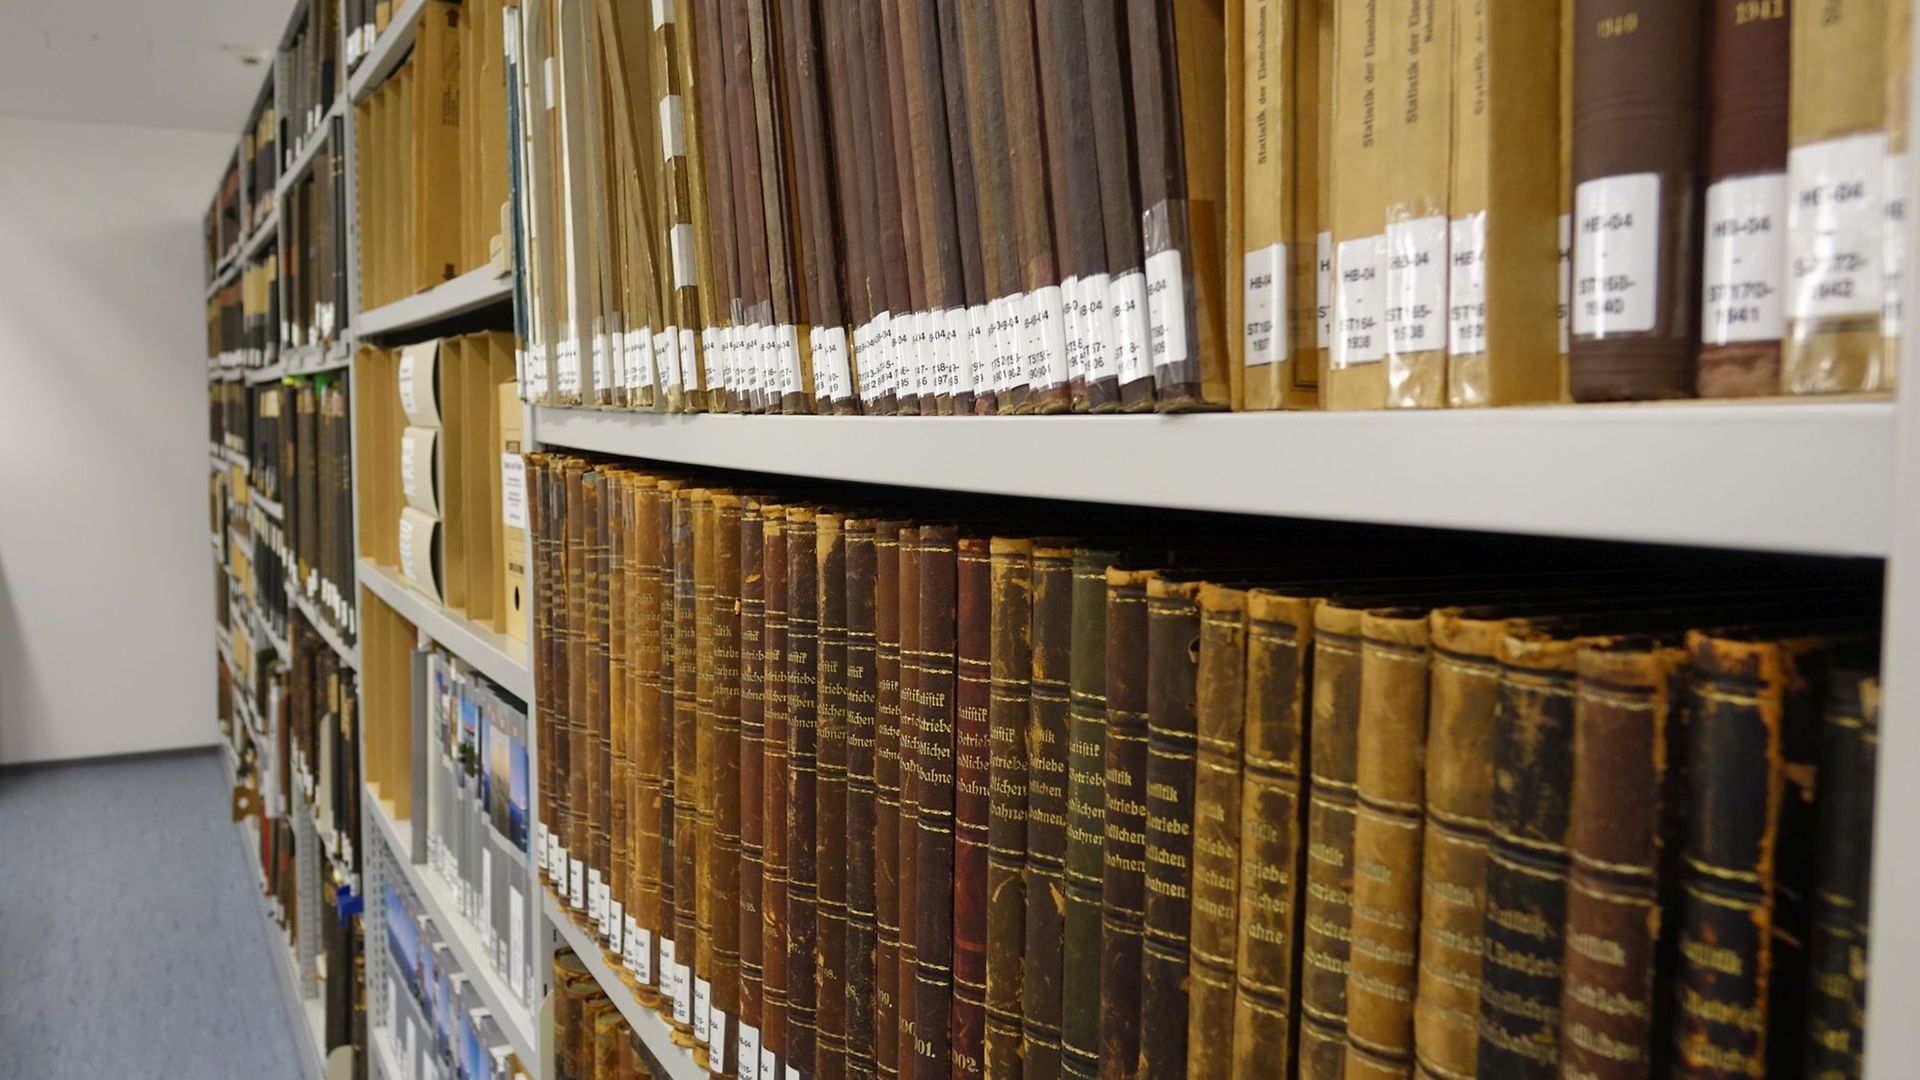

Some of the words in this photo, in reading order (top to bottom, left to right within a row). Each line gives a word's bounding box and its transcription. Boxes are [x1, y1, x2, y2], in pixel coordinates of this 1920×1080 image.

[1408, 33, 1420, 56] der
[1364, 63, 1376, 83] der
[1257, 85, 1267, 105] der
[1406, 60, 1420, 125] Statistik
[1362, 87, 1376, 148] Statistik
[1257, 108, 1267, 165] Statistik
[1343, 267, 1377, 283] HB-04
[1385, 304, 1433, 322] ST65-
